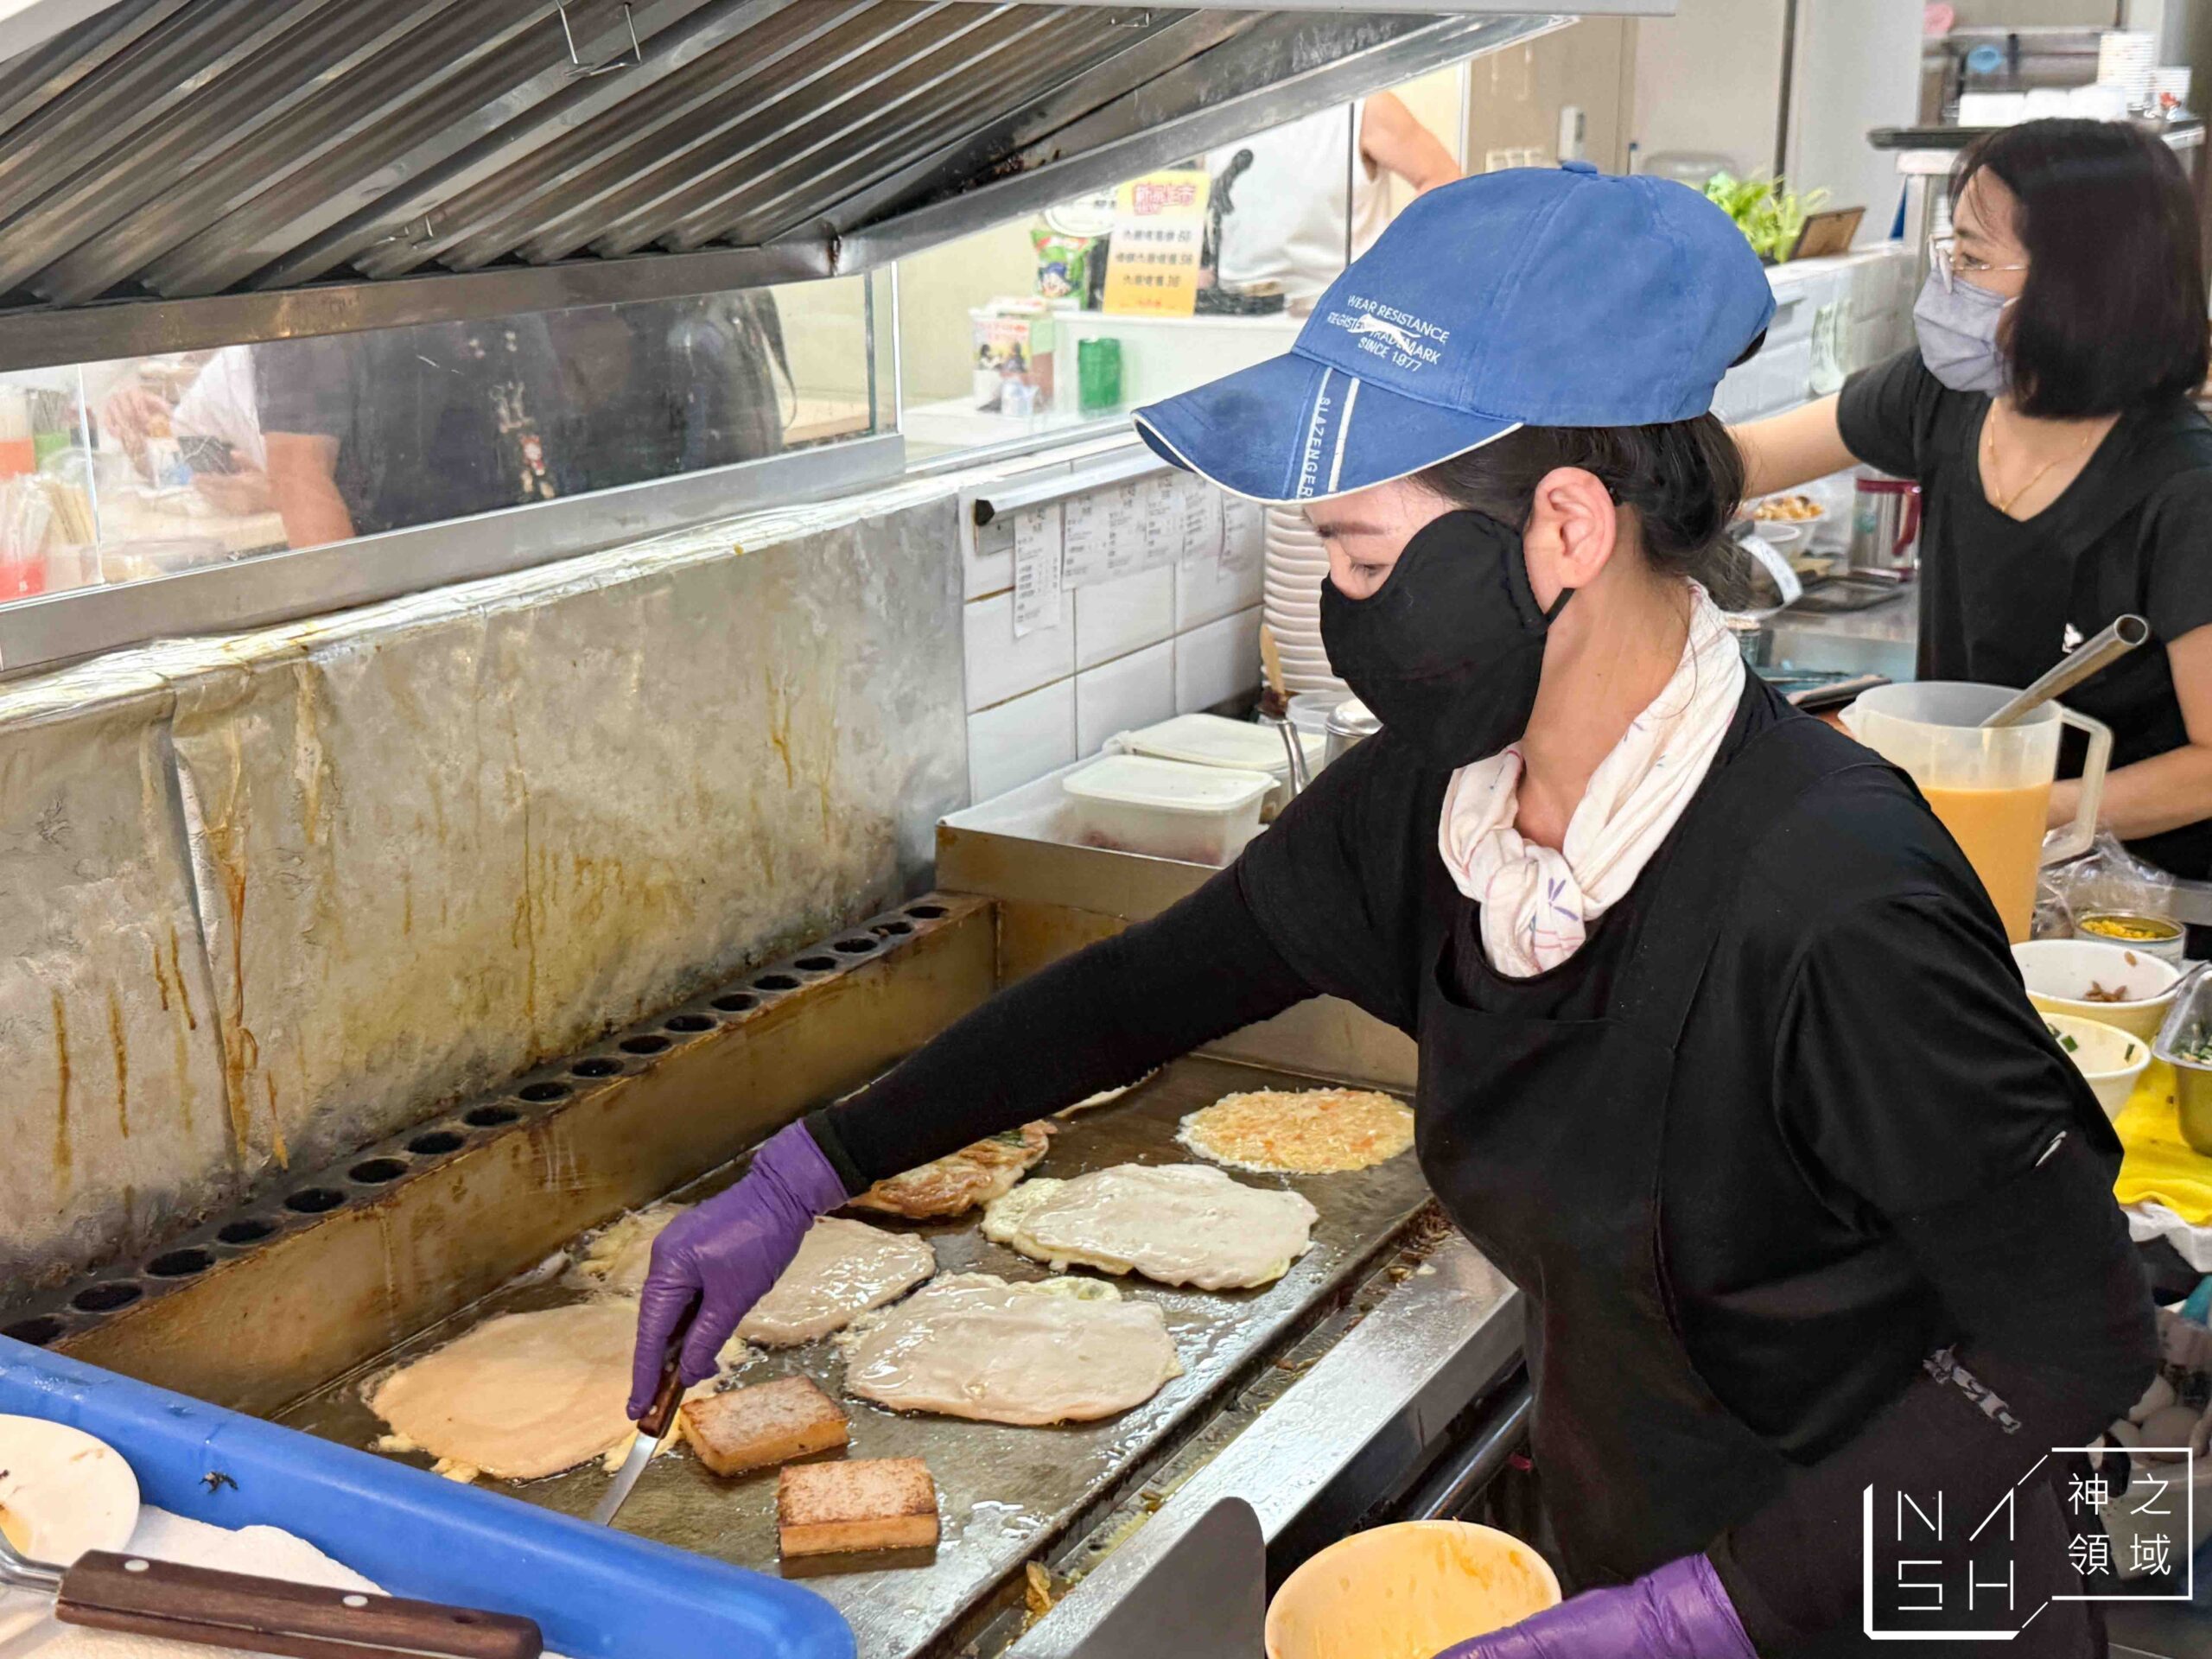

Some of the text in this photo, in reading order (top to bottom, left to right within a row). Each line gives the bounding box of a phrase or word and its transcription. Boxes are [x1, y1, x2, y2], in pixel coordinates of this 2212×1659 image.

[1347, 295, 1450, 345] WEAR RESISTANCE
[1357, 337, 1422, 372] SINCE 1977
[1298, 397, 1331, 499] SLAZENGER
